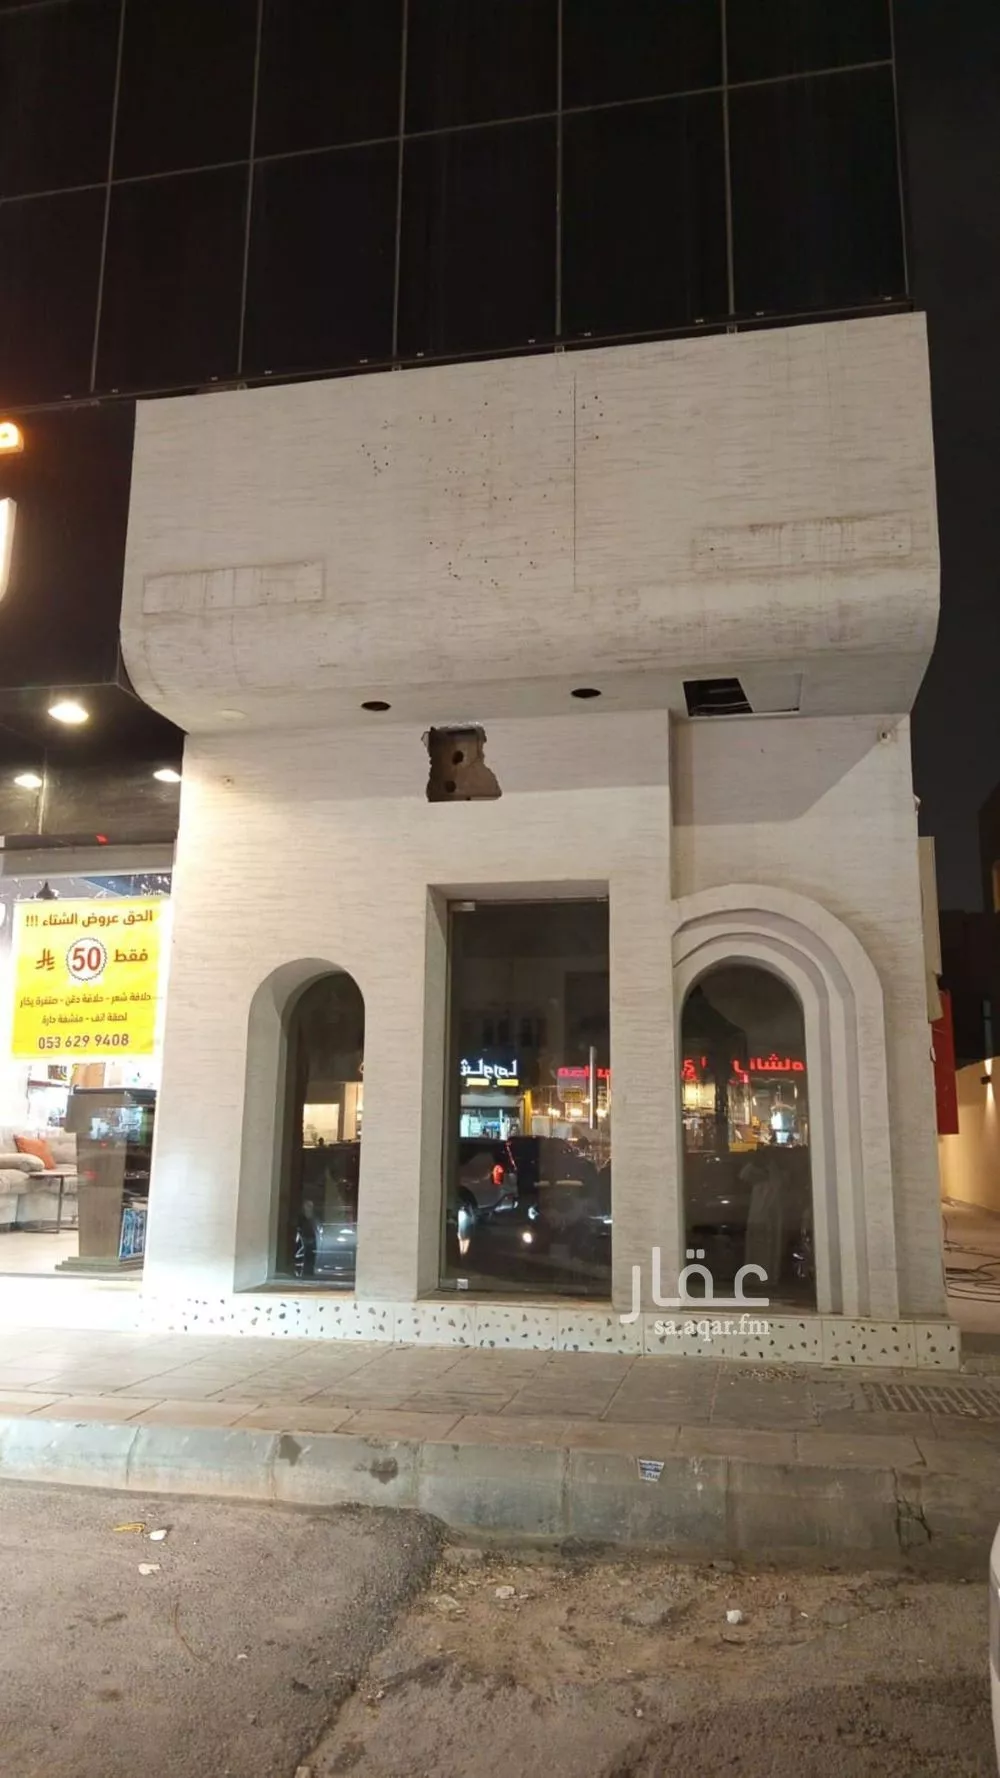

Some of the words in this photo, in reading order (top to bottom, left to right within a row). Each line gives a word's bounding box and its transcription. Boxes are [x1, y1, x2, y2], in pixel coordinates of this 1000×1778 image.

[42, 912, 78, 926] الشتاء
[82, 912, 119, 928] عروض
[123, 910, 153, 925] الحق
[72, 946, 102, 971] 50
[114, 949, 149, 962] فقط
[38, 1036, 61, 1050] 053
[65, 1035, 90, 1048] 629
[95, 1033, 129, 1047] 9408
